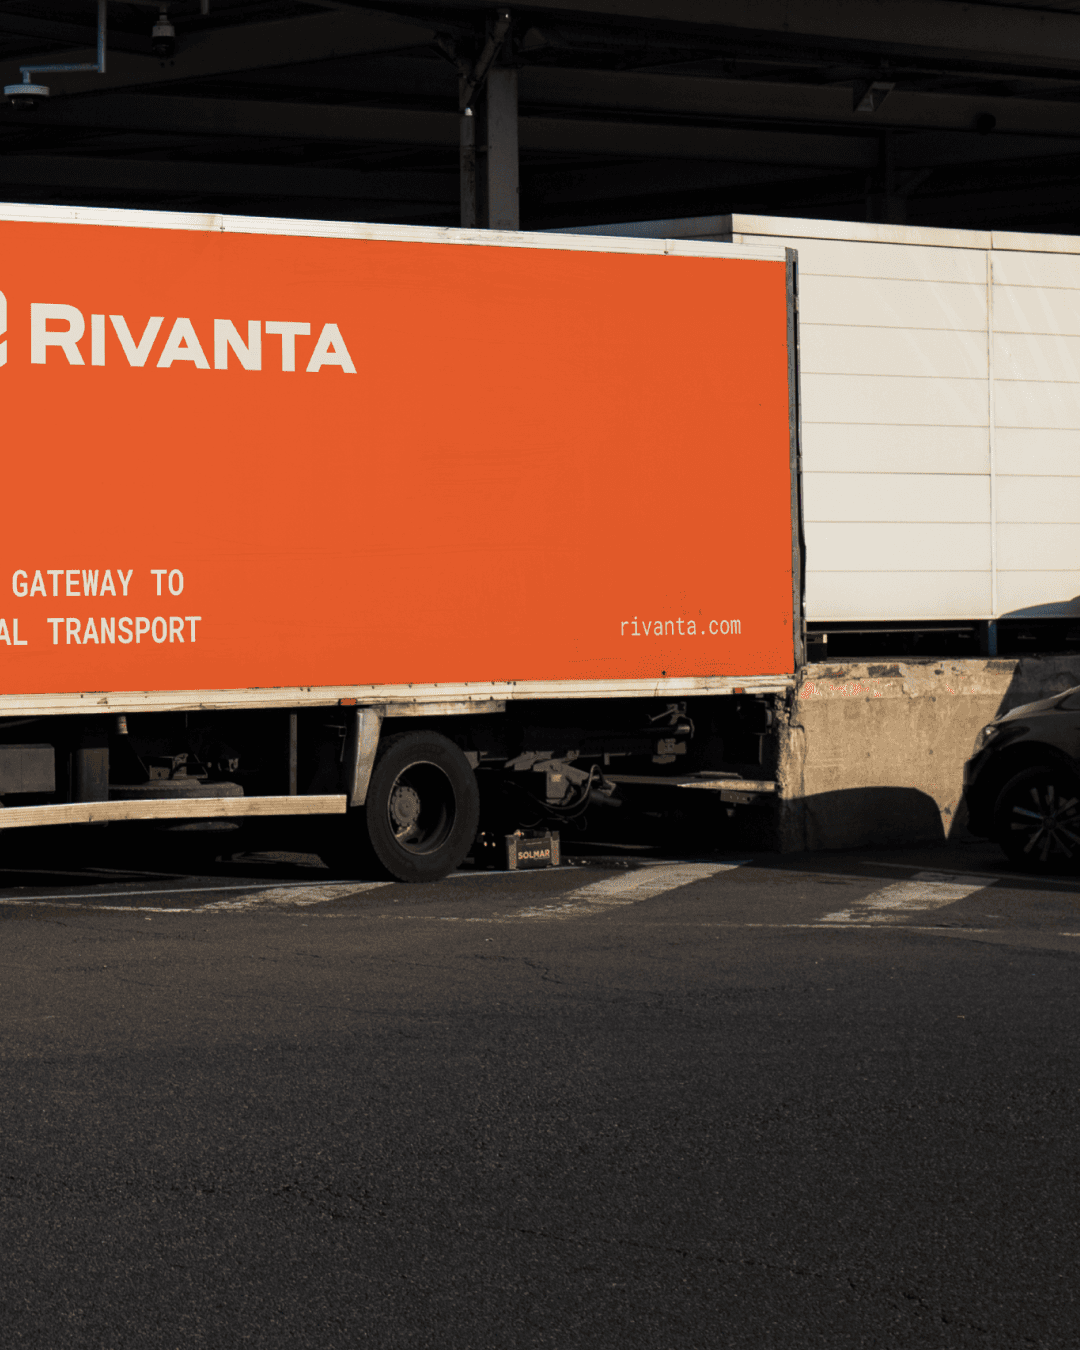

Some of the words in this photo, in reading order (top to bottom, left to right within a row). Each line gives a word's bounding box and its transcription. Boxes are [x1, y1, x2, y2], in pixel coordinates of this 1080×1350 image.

[30, 303, 358, 374] RIVANTA
[11, 569, 134, 598] GATEWAY
[150, 568, 185, 596] TO
[46, 615, 202, 645] TRANSPORT
[620, 616, 742, 637] rivanta.com
[518, 849, 550, 860] SOLMAR
